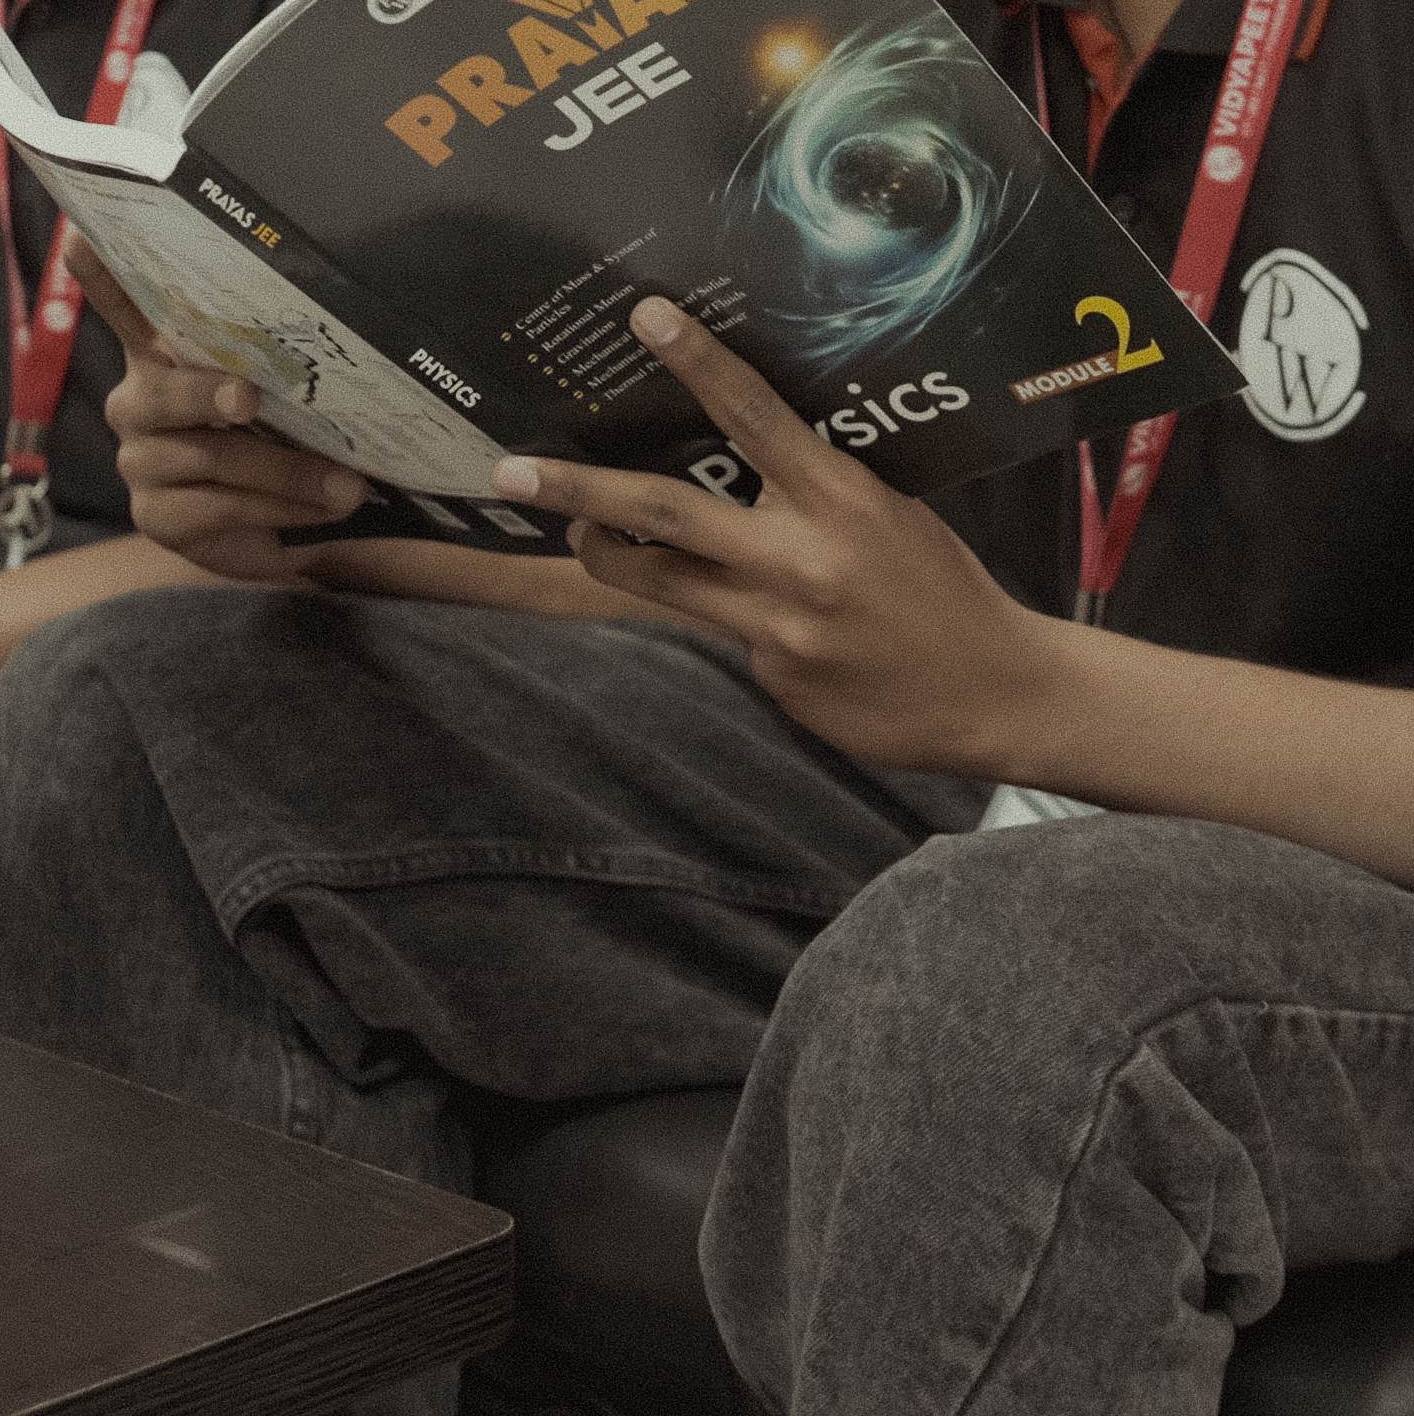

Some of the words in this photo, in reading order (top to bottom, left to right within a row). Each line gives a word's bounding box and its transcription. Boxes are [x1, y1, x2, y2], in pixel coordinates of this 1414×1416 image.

[544, 42, 692, 151] JEE
[197, 178, 256, 228] PRAYAS
[251, 222, 282, 248] JEE
[515, 301, 551, 330] Centre
[551, 289, 564, 303] of
[562, 272, 592, 292] Mass
[603, 238, 645, 264] System
[644, 228, 657, 241] of
[526, 304, 572, 339] Particles
[541, 308, 596, 352] Rotational
[592, 284, 635, 312] Motion
[557, 321, 617, 364] Gravitation
[572, 331, 632, 376] Mechanical
[696, 276, 732, 295] Solids
[1013, 357, 1115, 402] MODULE
[1074, 295, 1165, 374] 2
[408, 348, 482, 408] PHYSICS
[587, 345, 647, 388] Mechanical
[603, 367, 648, 400] Thermal
